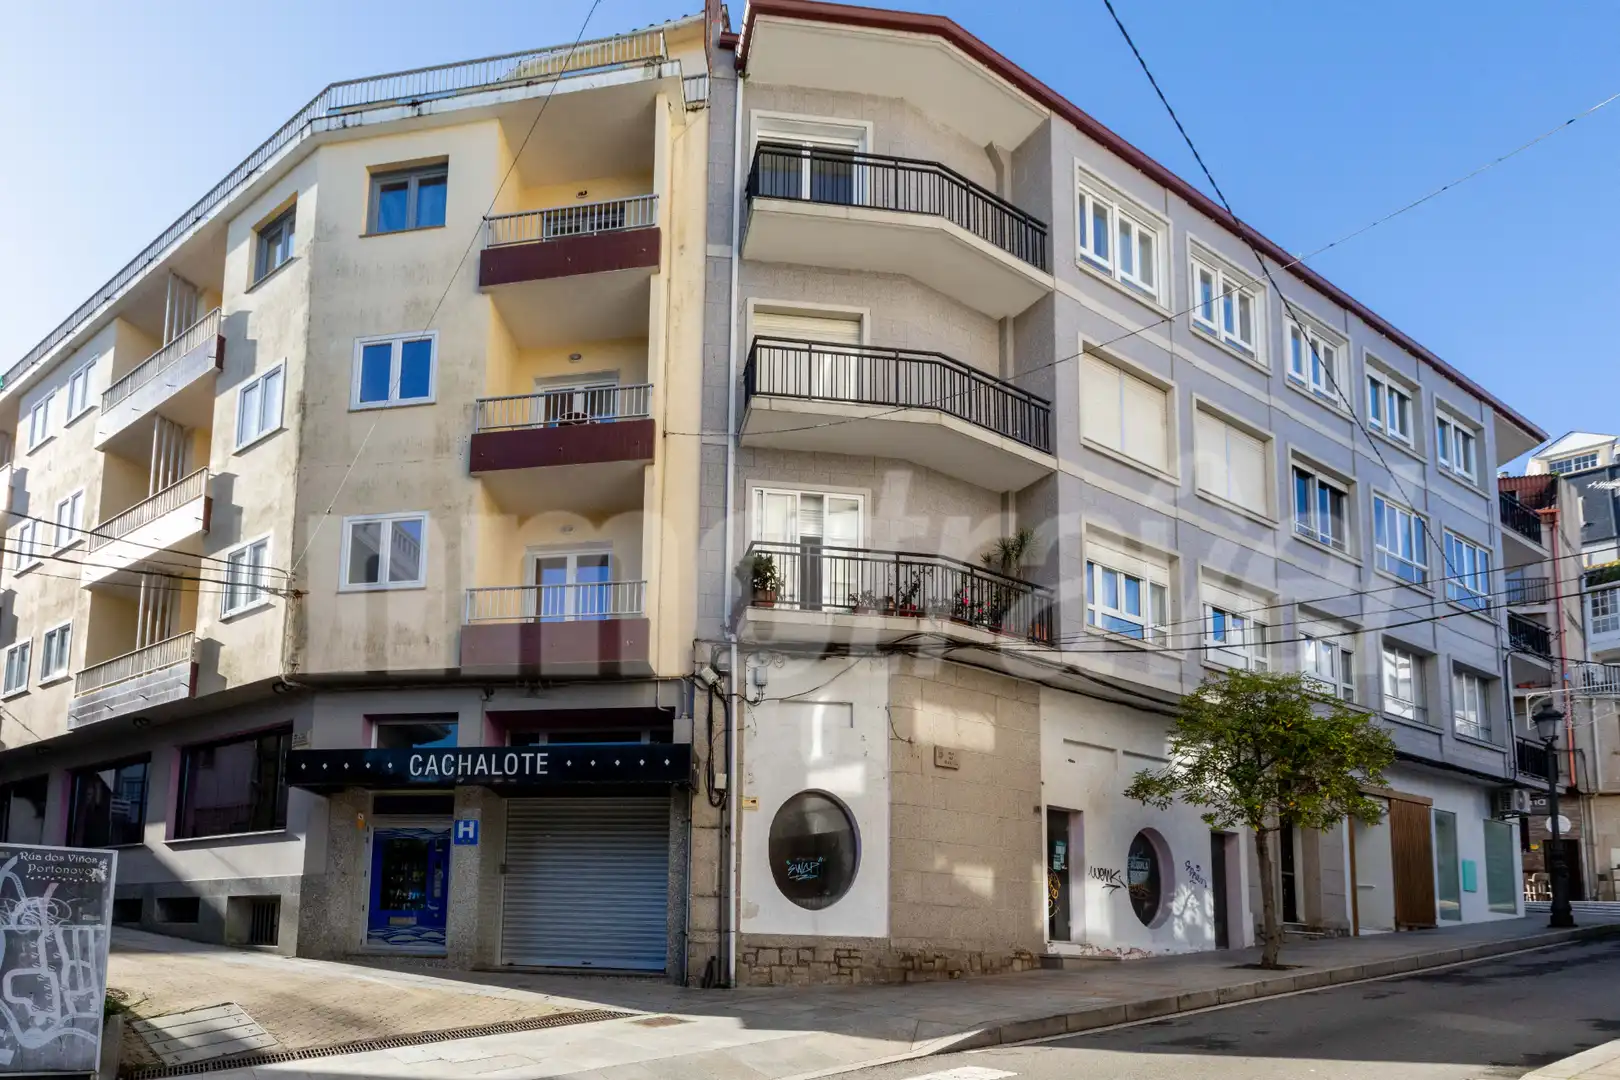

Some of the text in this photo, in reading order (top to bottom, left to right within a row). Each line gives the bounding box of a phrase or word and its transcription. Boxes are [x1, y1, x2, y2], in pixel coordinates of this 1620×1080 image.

[409, 752, 550, 777] CACHALOTE
[457, 820, 475, 839] H
[19, 851, 98, 864] Rúa dos Viños
[27, 863, 92, 874] Portonovo
